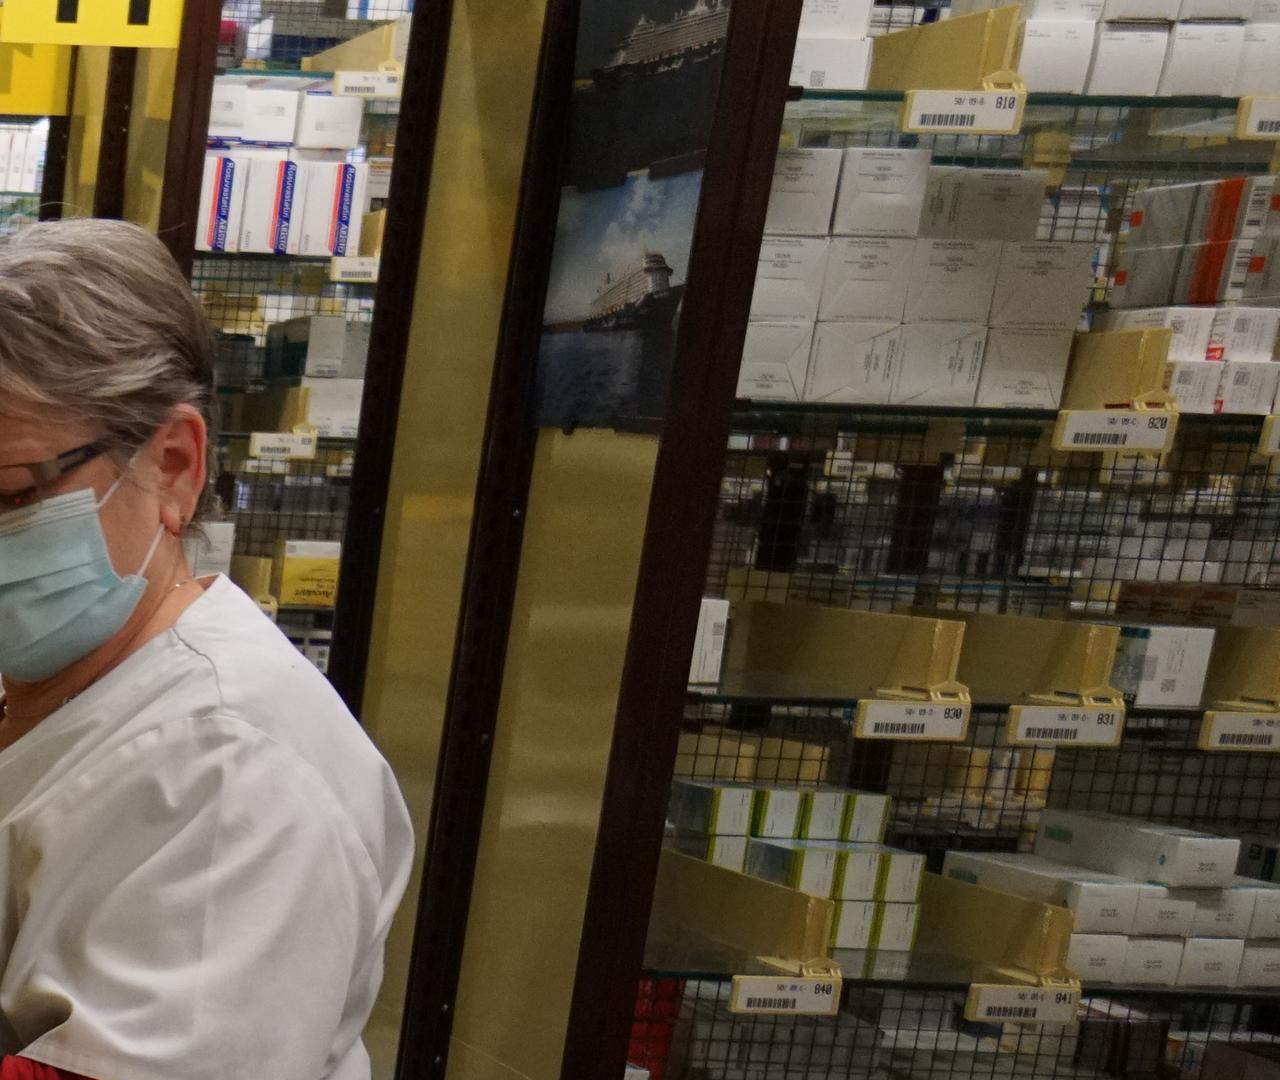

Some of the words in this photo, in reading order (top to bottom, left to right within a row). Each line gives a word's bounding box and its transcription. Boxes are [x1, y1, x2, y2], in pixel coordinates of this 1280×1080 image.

[995, 96, 1016, 109] 810
[219, 161, 234, 216] Rosuvastatin
[283, 164, 297, 218] Rosuvastatin
[342, 167, 356, 222] Rosuvastatin
[1147, 416, 1168, 429] 820
[943, 707, 963, 719] 830
[1096, 713, 1116, 725] 831
